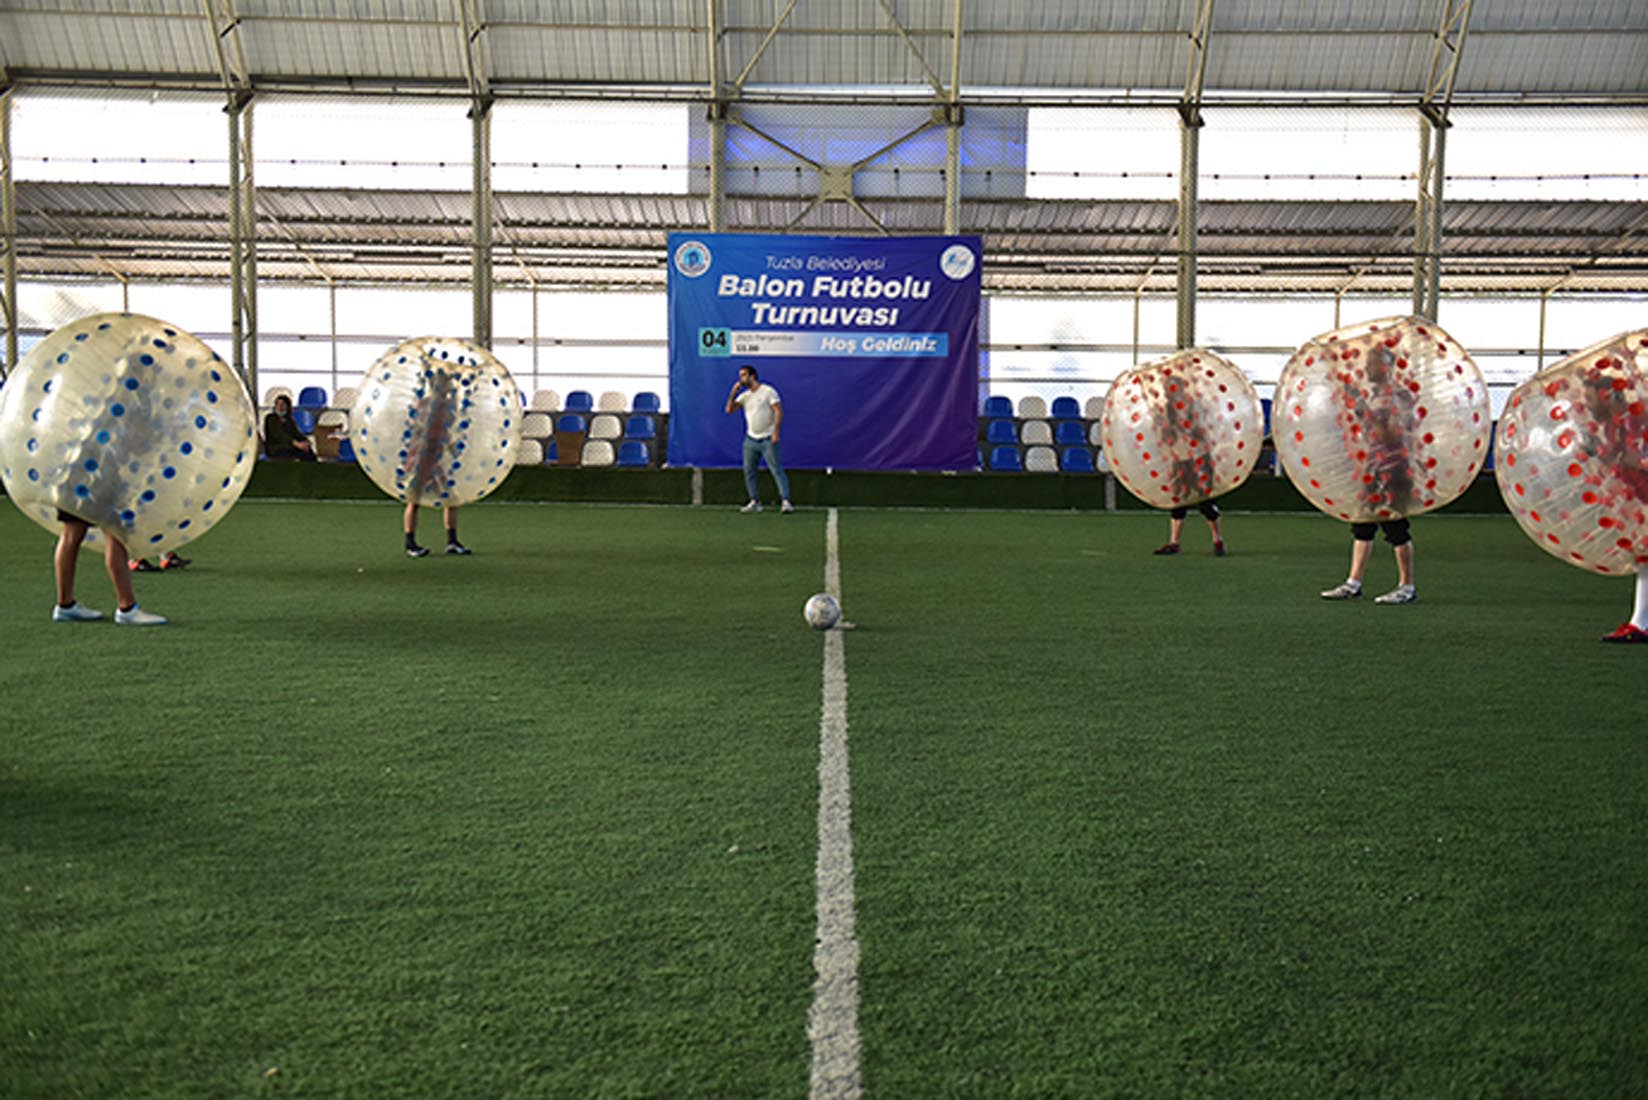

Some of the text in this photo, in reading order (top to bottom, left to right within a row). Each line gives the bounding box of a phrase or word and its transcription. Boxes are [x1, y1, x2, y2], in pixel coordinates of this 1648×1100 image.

[767, 255, 886, 273] Tuzla Belediyesi
[718, 274, 931, 299] Balon Futbolu
[752, 303, 898, 325] Turnuvası
[702, 330, 726, 348] 04
[821, 336, 937, 354] Hoş Geldiniz
